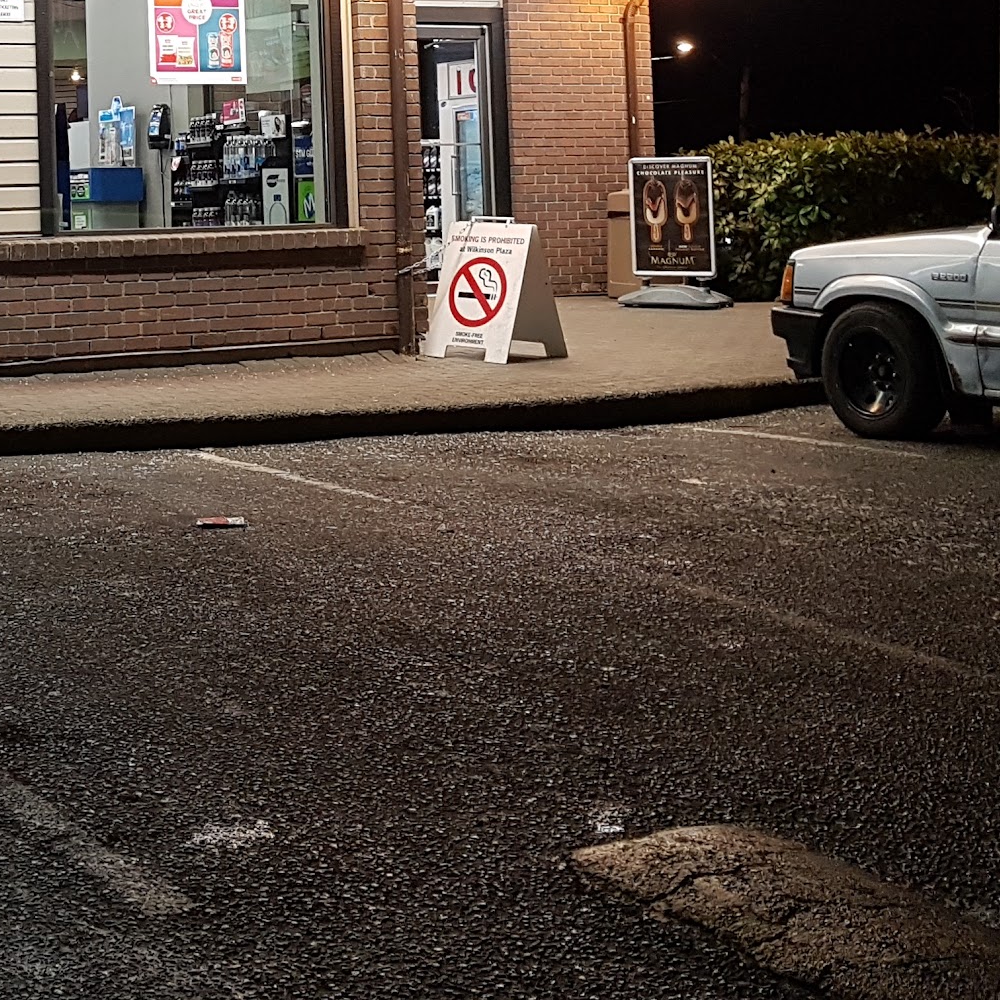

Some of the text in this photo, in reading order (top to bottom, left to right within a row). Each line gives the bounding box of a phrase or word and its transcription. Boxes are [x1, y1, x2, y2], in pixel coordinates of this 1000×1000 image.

[452, 235, 479, 243] SMOKING
[488, 236, 525, 244] PROHIBITED
[651, 256, 696, 265] MAGNUM
